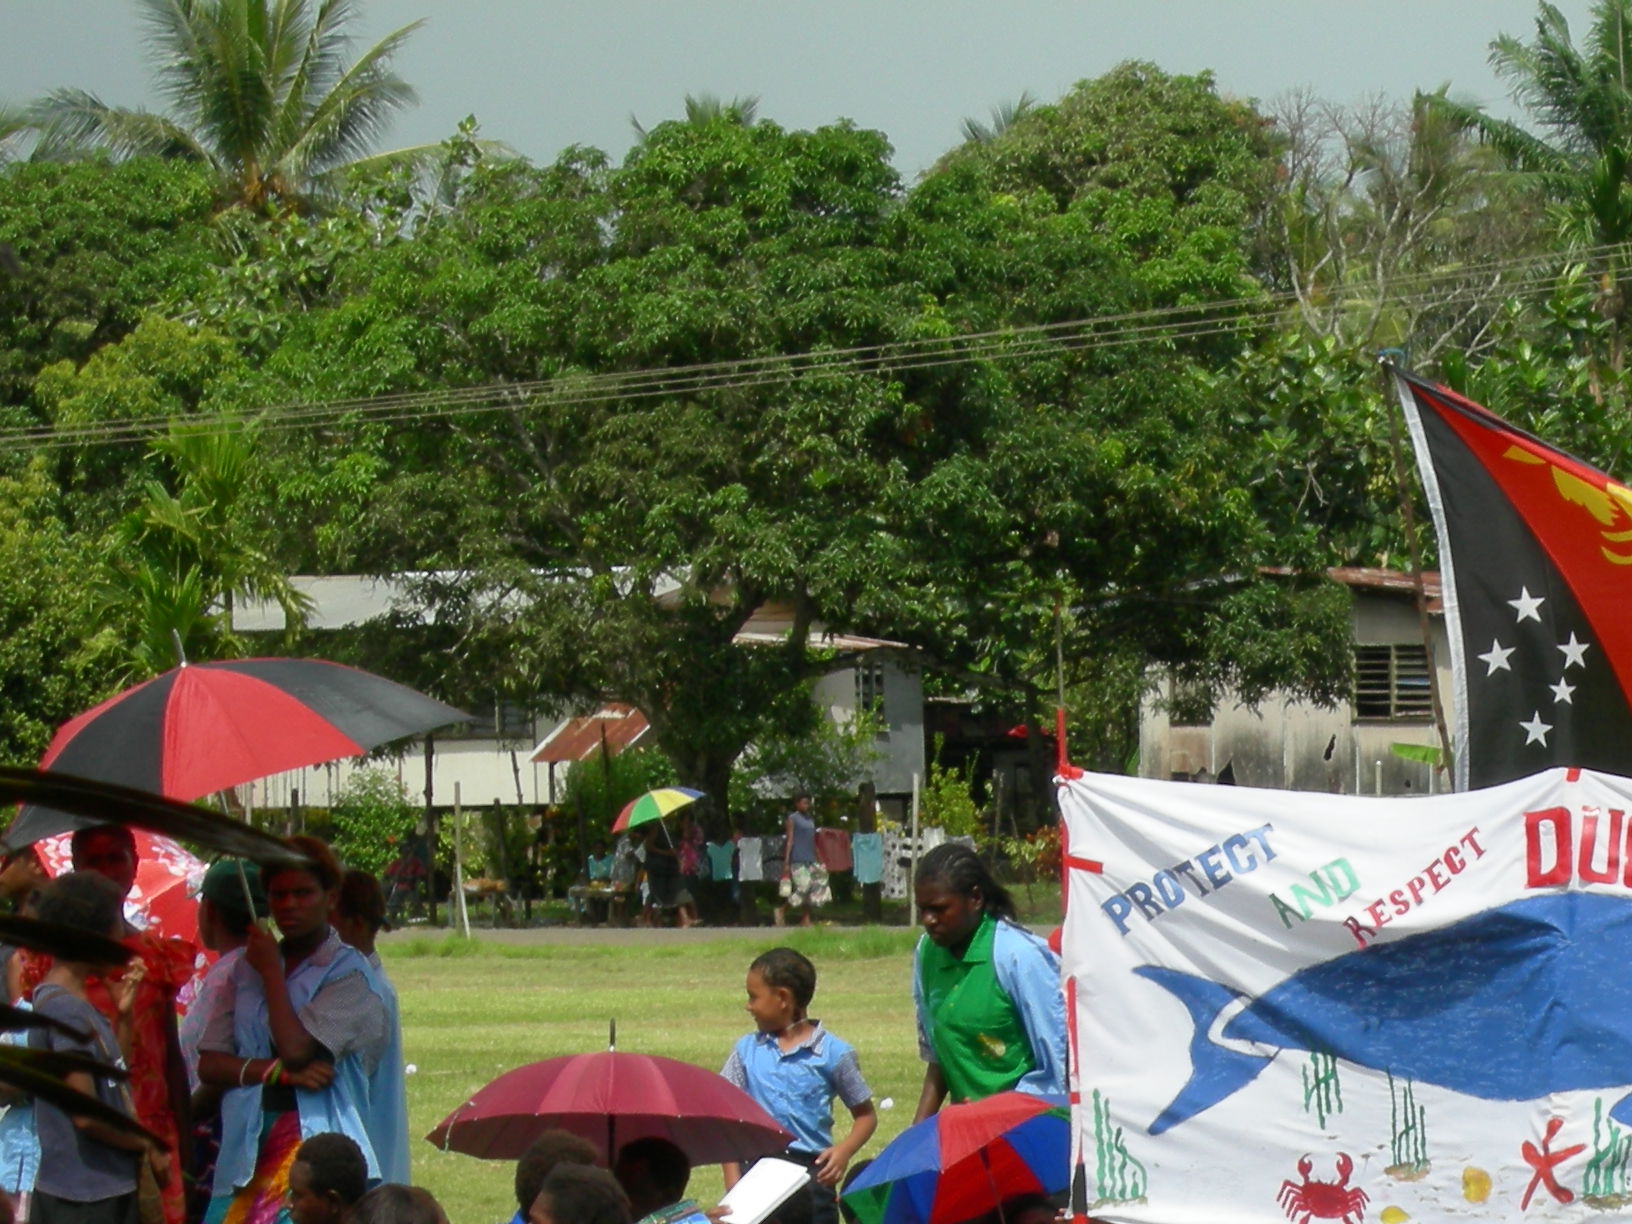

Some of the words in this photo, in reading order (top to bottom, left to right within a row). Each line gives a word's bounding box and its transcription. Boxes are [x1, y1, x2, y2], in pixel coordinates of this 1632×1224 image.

[1101, 823, 1278, 936] PROTECT
[1267, 857, 1361, 929] AND
[1343, 826, 1487, 949] RESPECT
